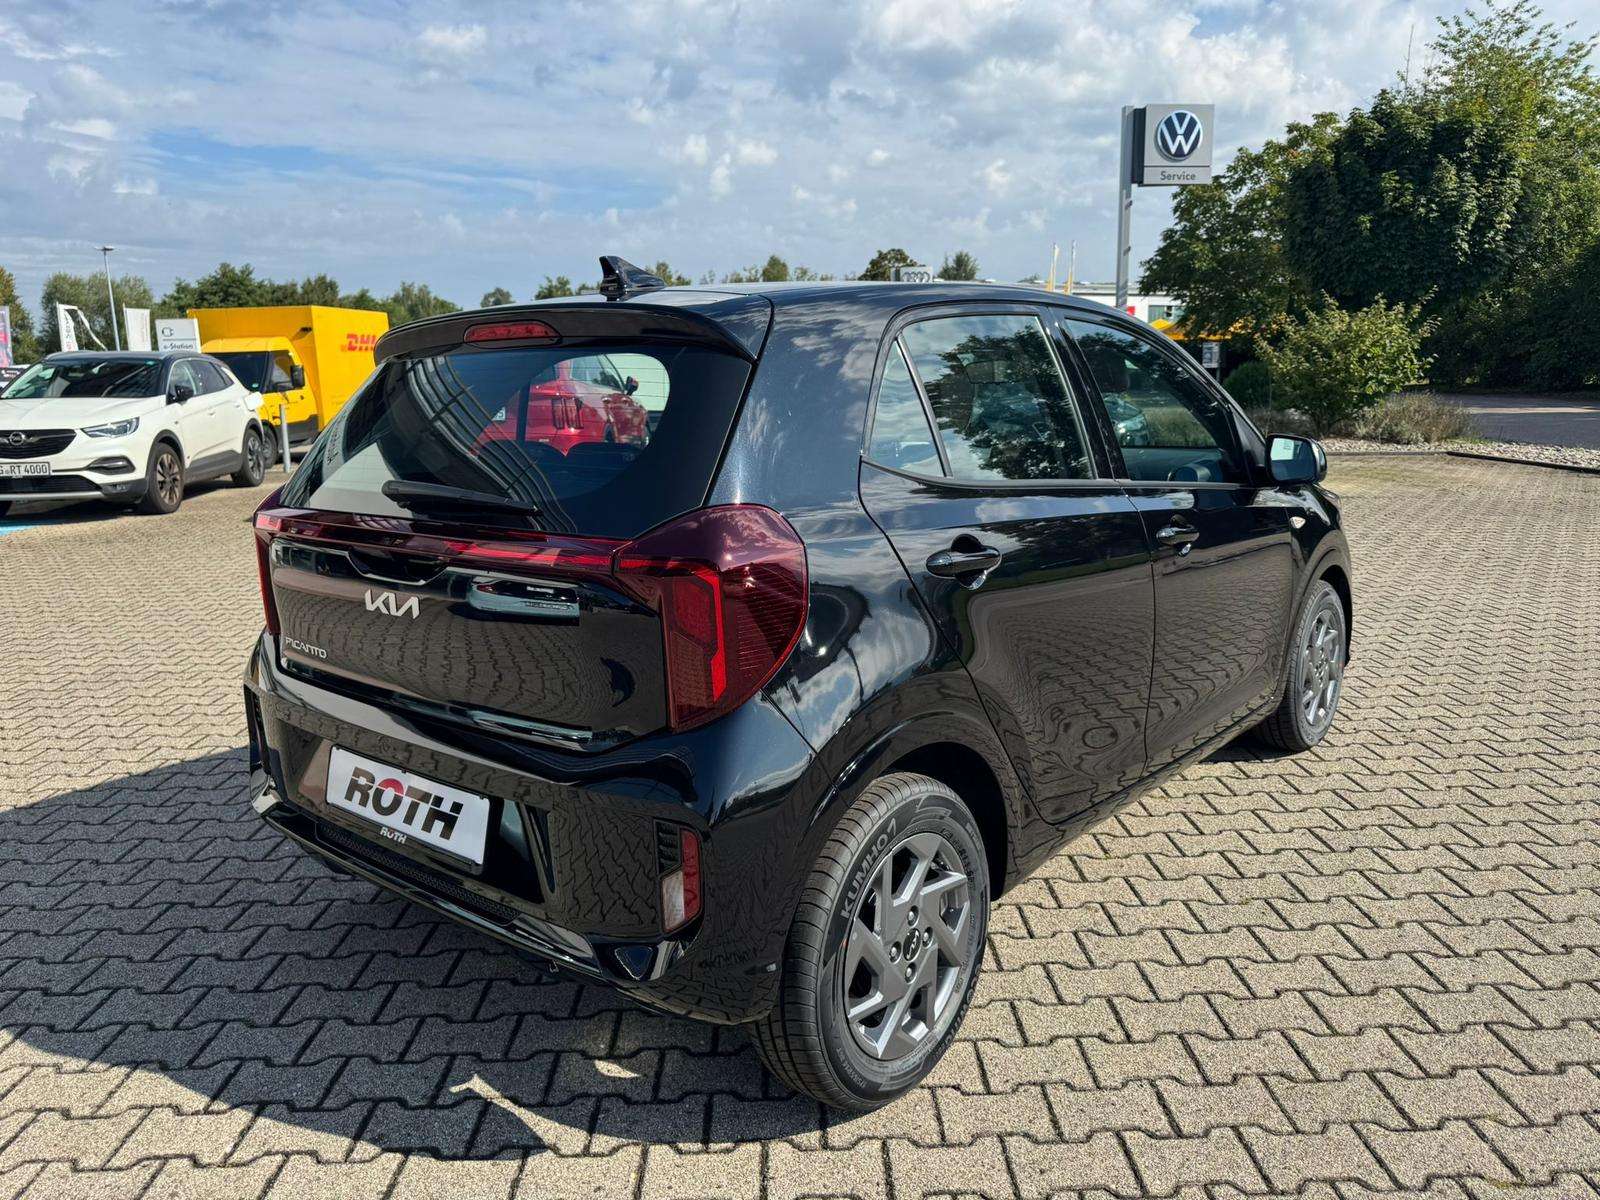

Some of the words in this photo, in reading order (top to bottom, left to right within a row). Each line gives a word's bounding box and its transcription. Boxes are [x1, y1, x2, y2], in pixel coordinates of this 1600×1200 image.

[1160, 171, 1196, 181] Service
[24, 464, 48, 474] 4000
[364, 589, 420, 620] KIA
[285, 637, 327, 659] PICANTO
[344, 766, 464, 841] ROTH
[379, 827, 407, 844] ROTH
[840, 833, 889, 919] KUMHO
